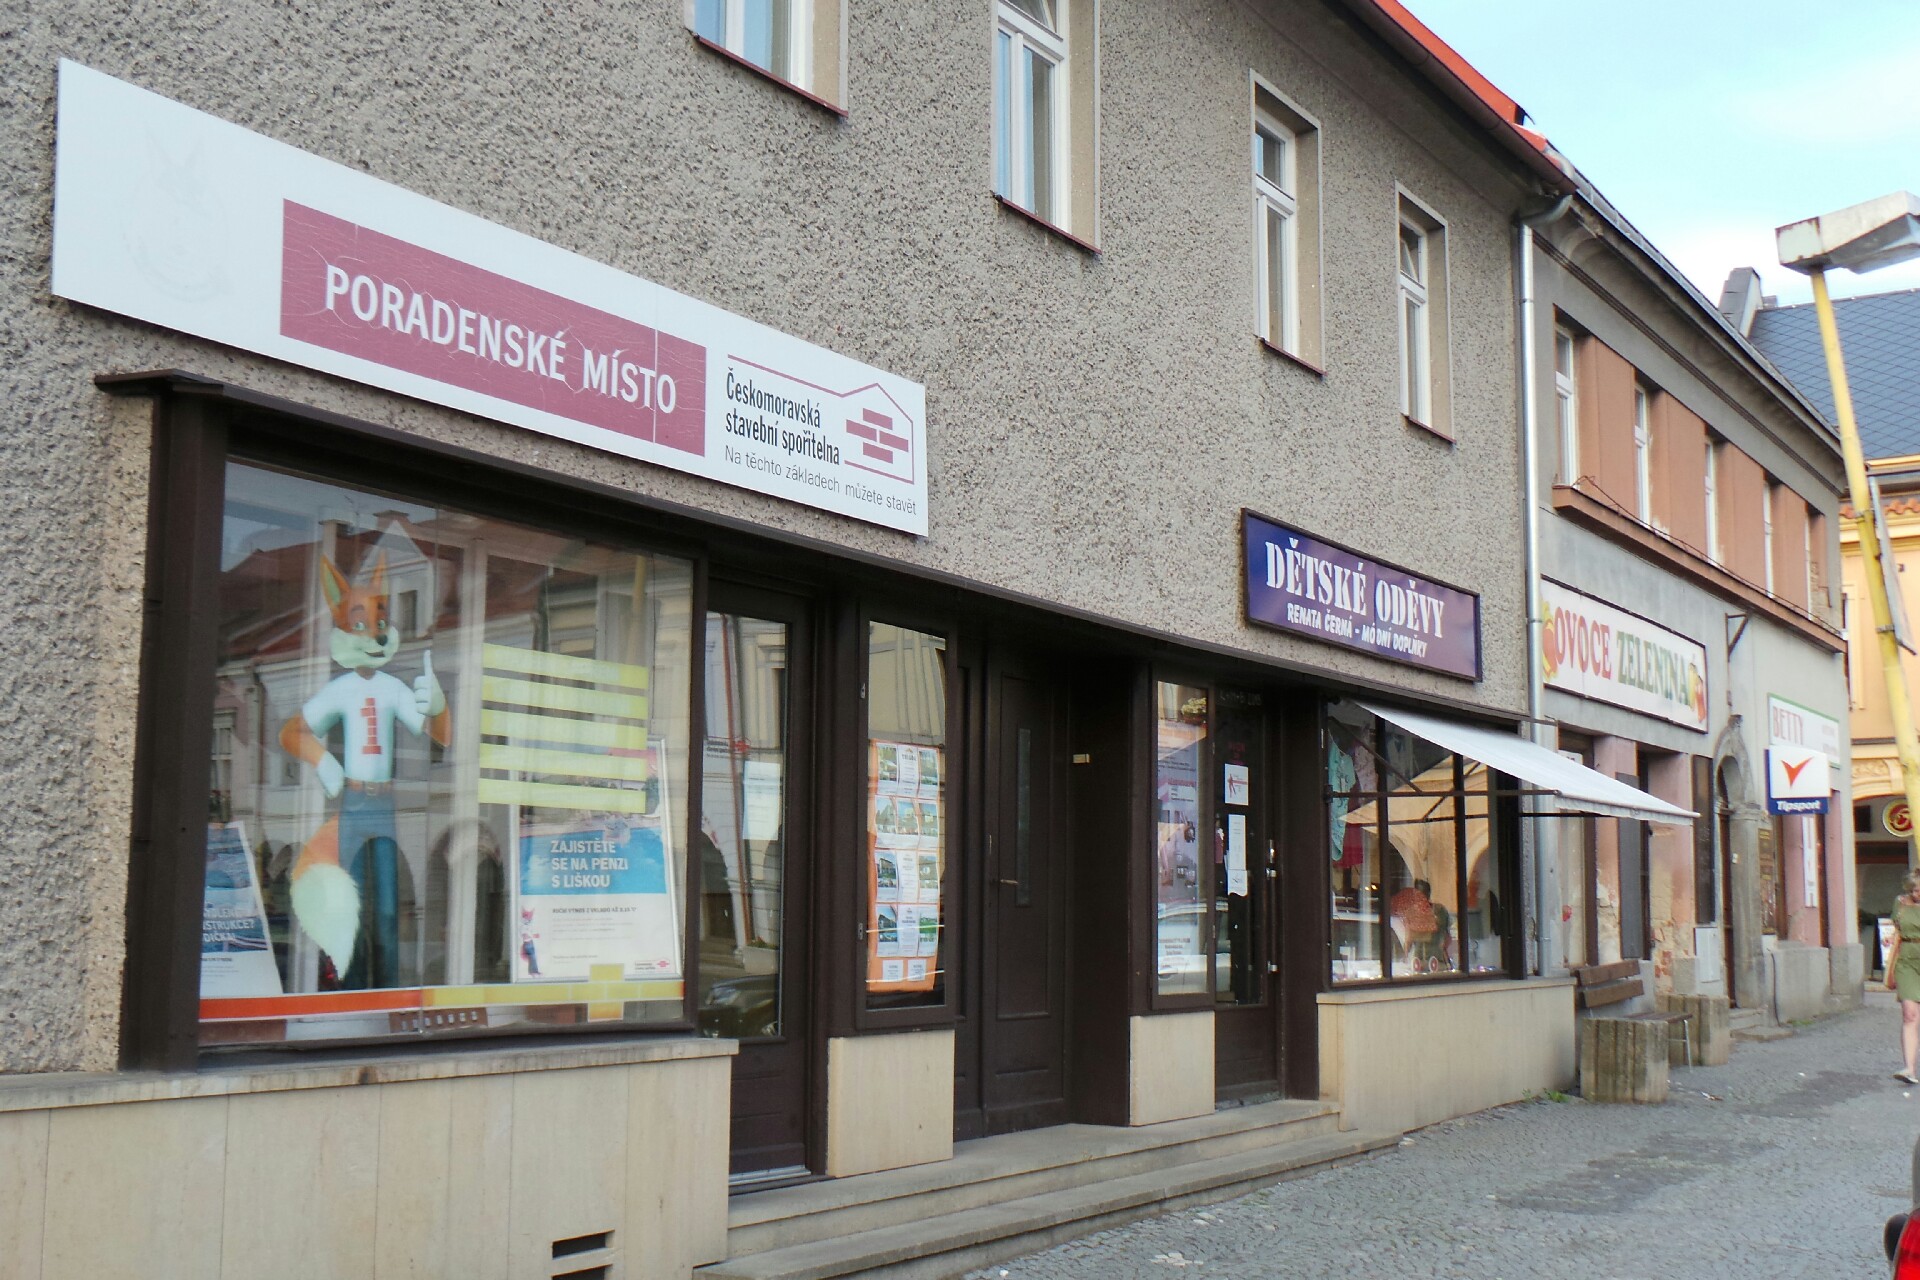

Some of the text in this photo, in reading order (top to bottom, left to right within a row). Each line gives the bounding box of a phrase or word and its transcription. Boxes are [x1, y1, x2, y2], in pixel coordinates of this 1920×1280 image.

[325, 264, 677, 414] PORADENSKÉ MÍSTO
[726, 366, 821, 429] Českomoravská
[725, 408, 840, 466] stavební spořitelna
[725, 445, 917, 516] Na těchto základech můžete stavět
[1265, 537, 1446, 639] DĚTSKÉ ODĚVY
[1287, 602, 1322, 631] RENATA
[1324, 609, 1353, 638] ČERNÁ
[1393, 634, 1428, 658] DOPLŇKY
[1554, 606, 1690, 706] OVOCE ZELENINA
[550, 837, 616, 854] ZAJISTĚTE
[551, 857, 629, 871] SE NA PENZI
[551, 872, 611, 888] S LIŠKOU
